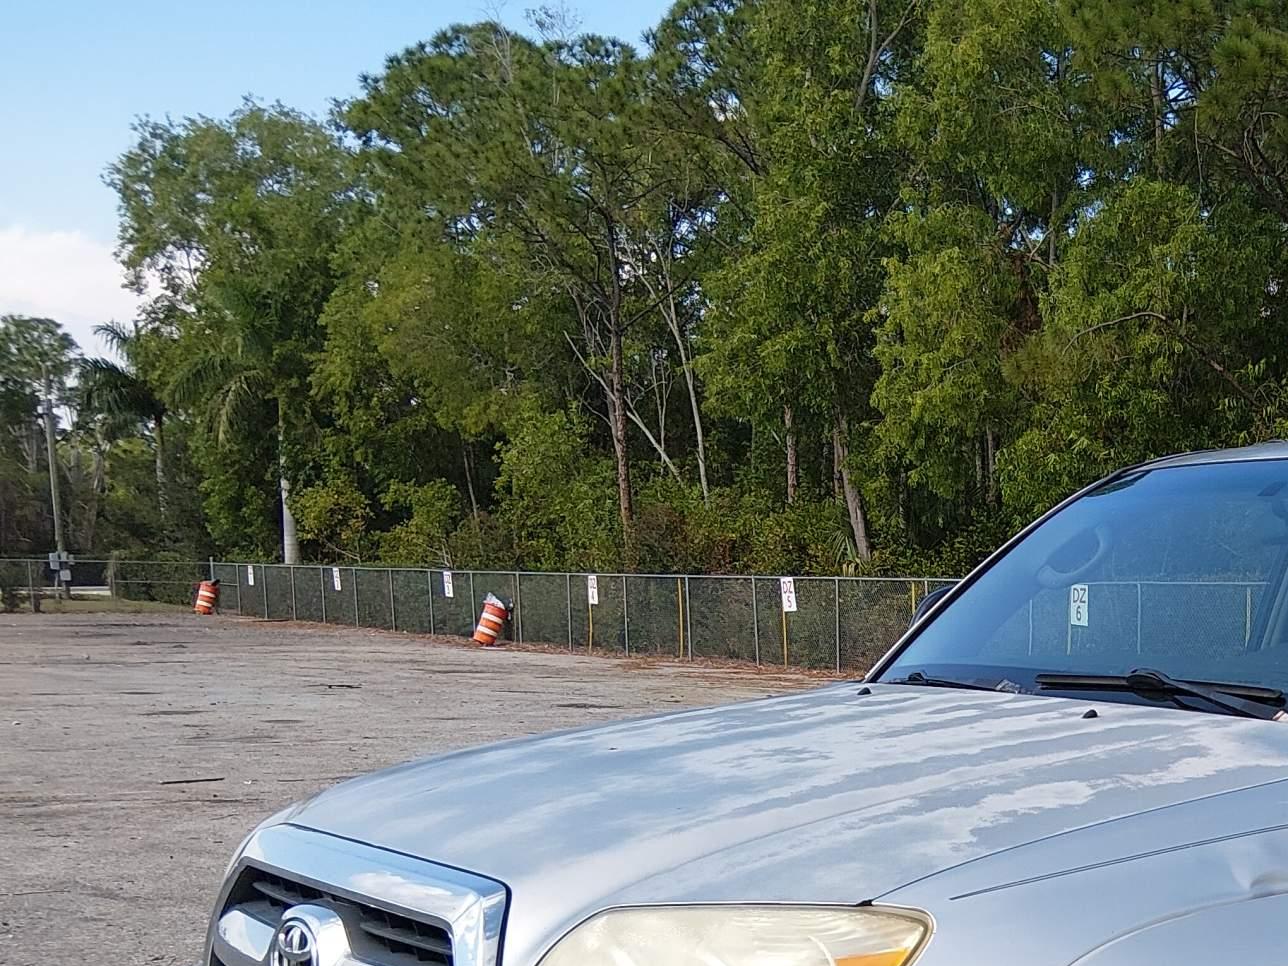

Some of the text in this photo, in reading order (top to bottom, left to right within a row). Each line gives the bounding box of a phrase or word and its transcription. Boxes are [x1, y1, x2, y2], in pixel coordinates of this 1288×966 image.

[782, 580, 793, 594] DZ
[786, 595, 793, 609] 5
[1072, 587, 1087, 604] DZ
[1075, 605, 1082, 622] 6
